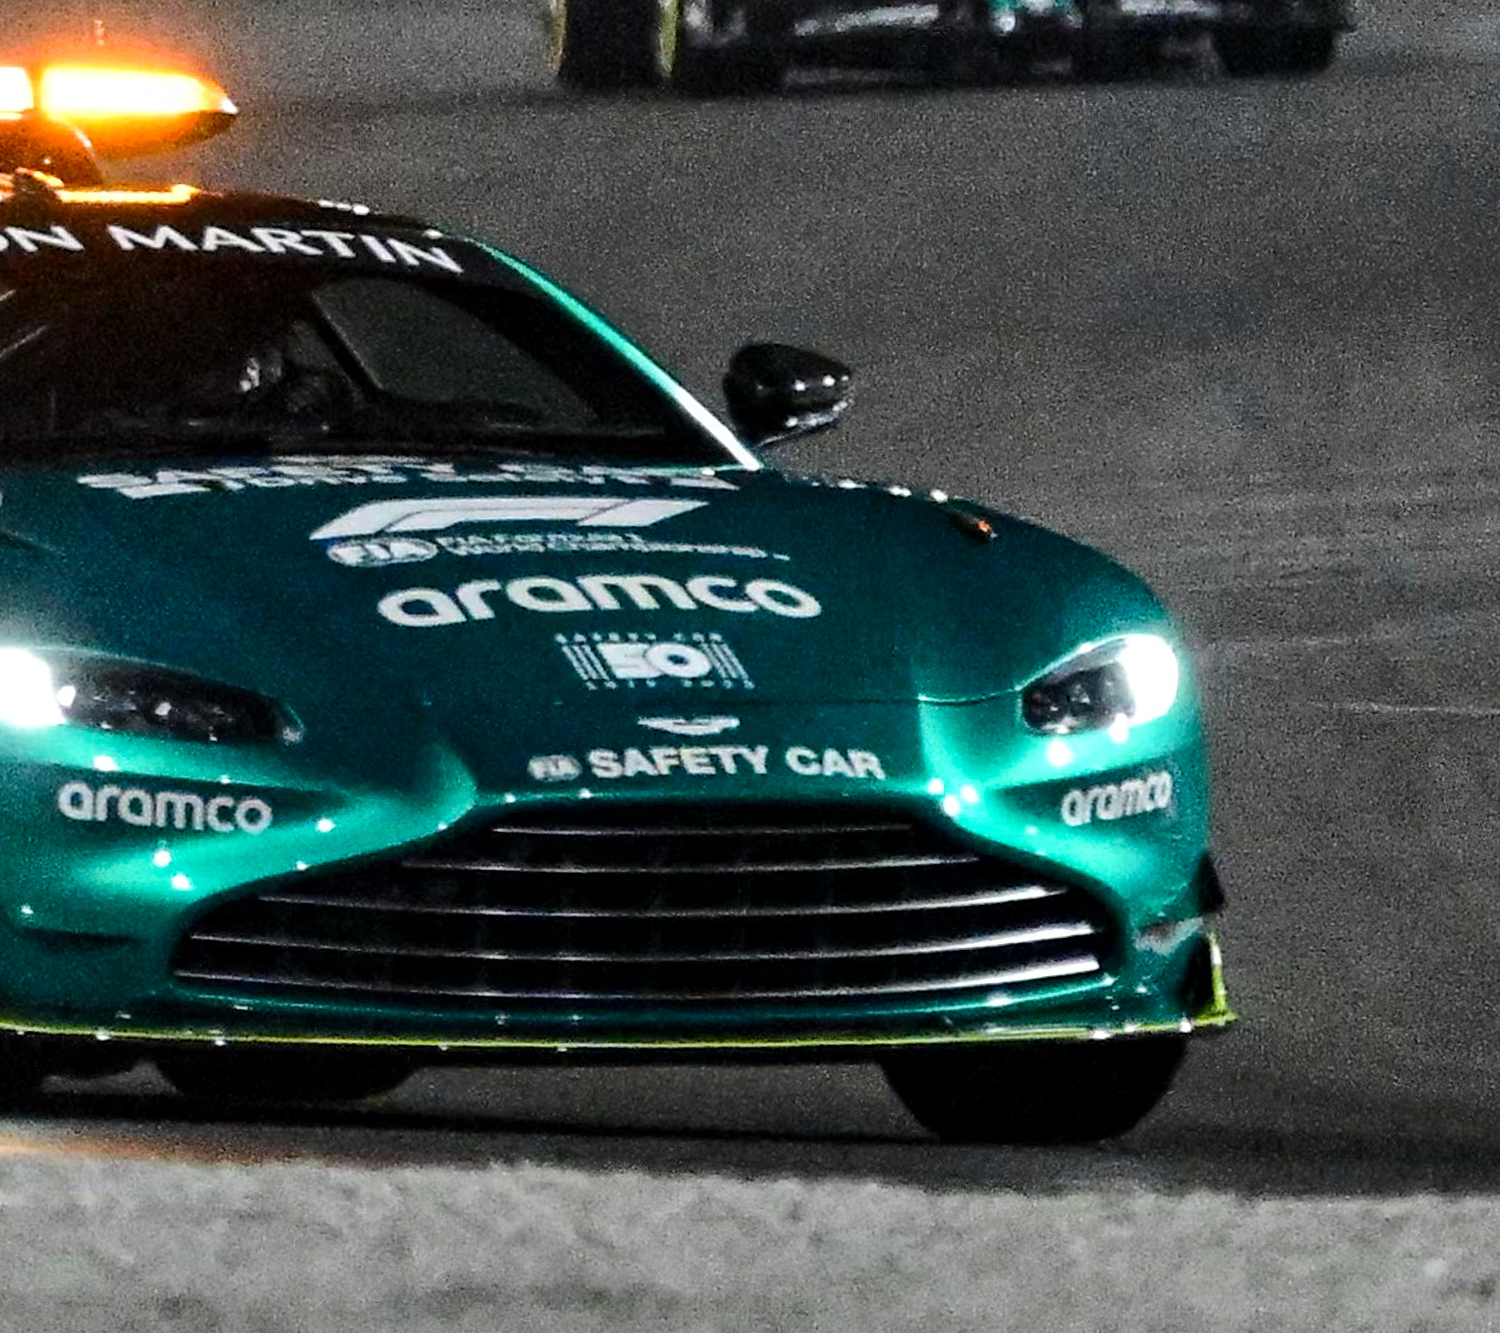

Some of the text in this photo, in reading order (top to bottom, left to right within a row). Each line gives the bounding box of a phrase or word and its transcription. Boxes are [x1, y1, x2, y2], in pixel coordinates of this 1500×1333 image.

[108, 223, 464, 275] MARTIN
[377, 574, 823, 629] aramco
[586, 745, 769, 780] SAFETY
[784, 746, 888, 782] CAR
[57, 781, 274, 835] aramco
[1060, 770, 1173, 827] aramco
